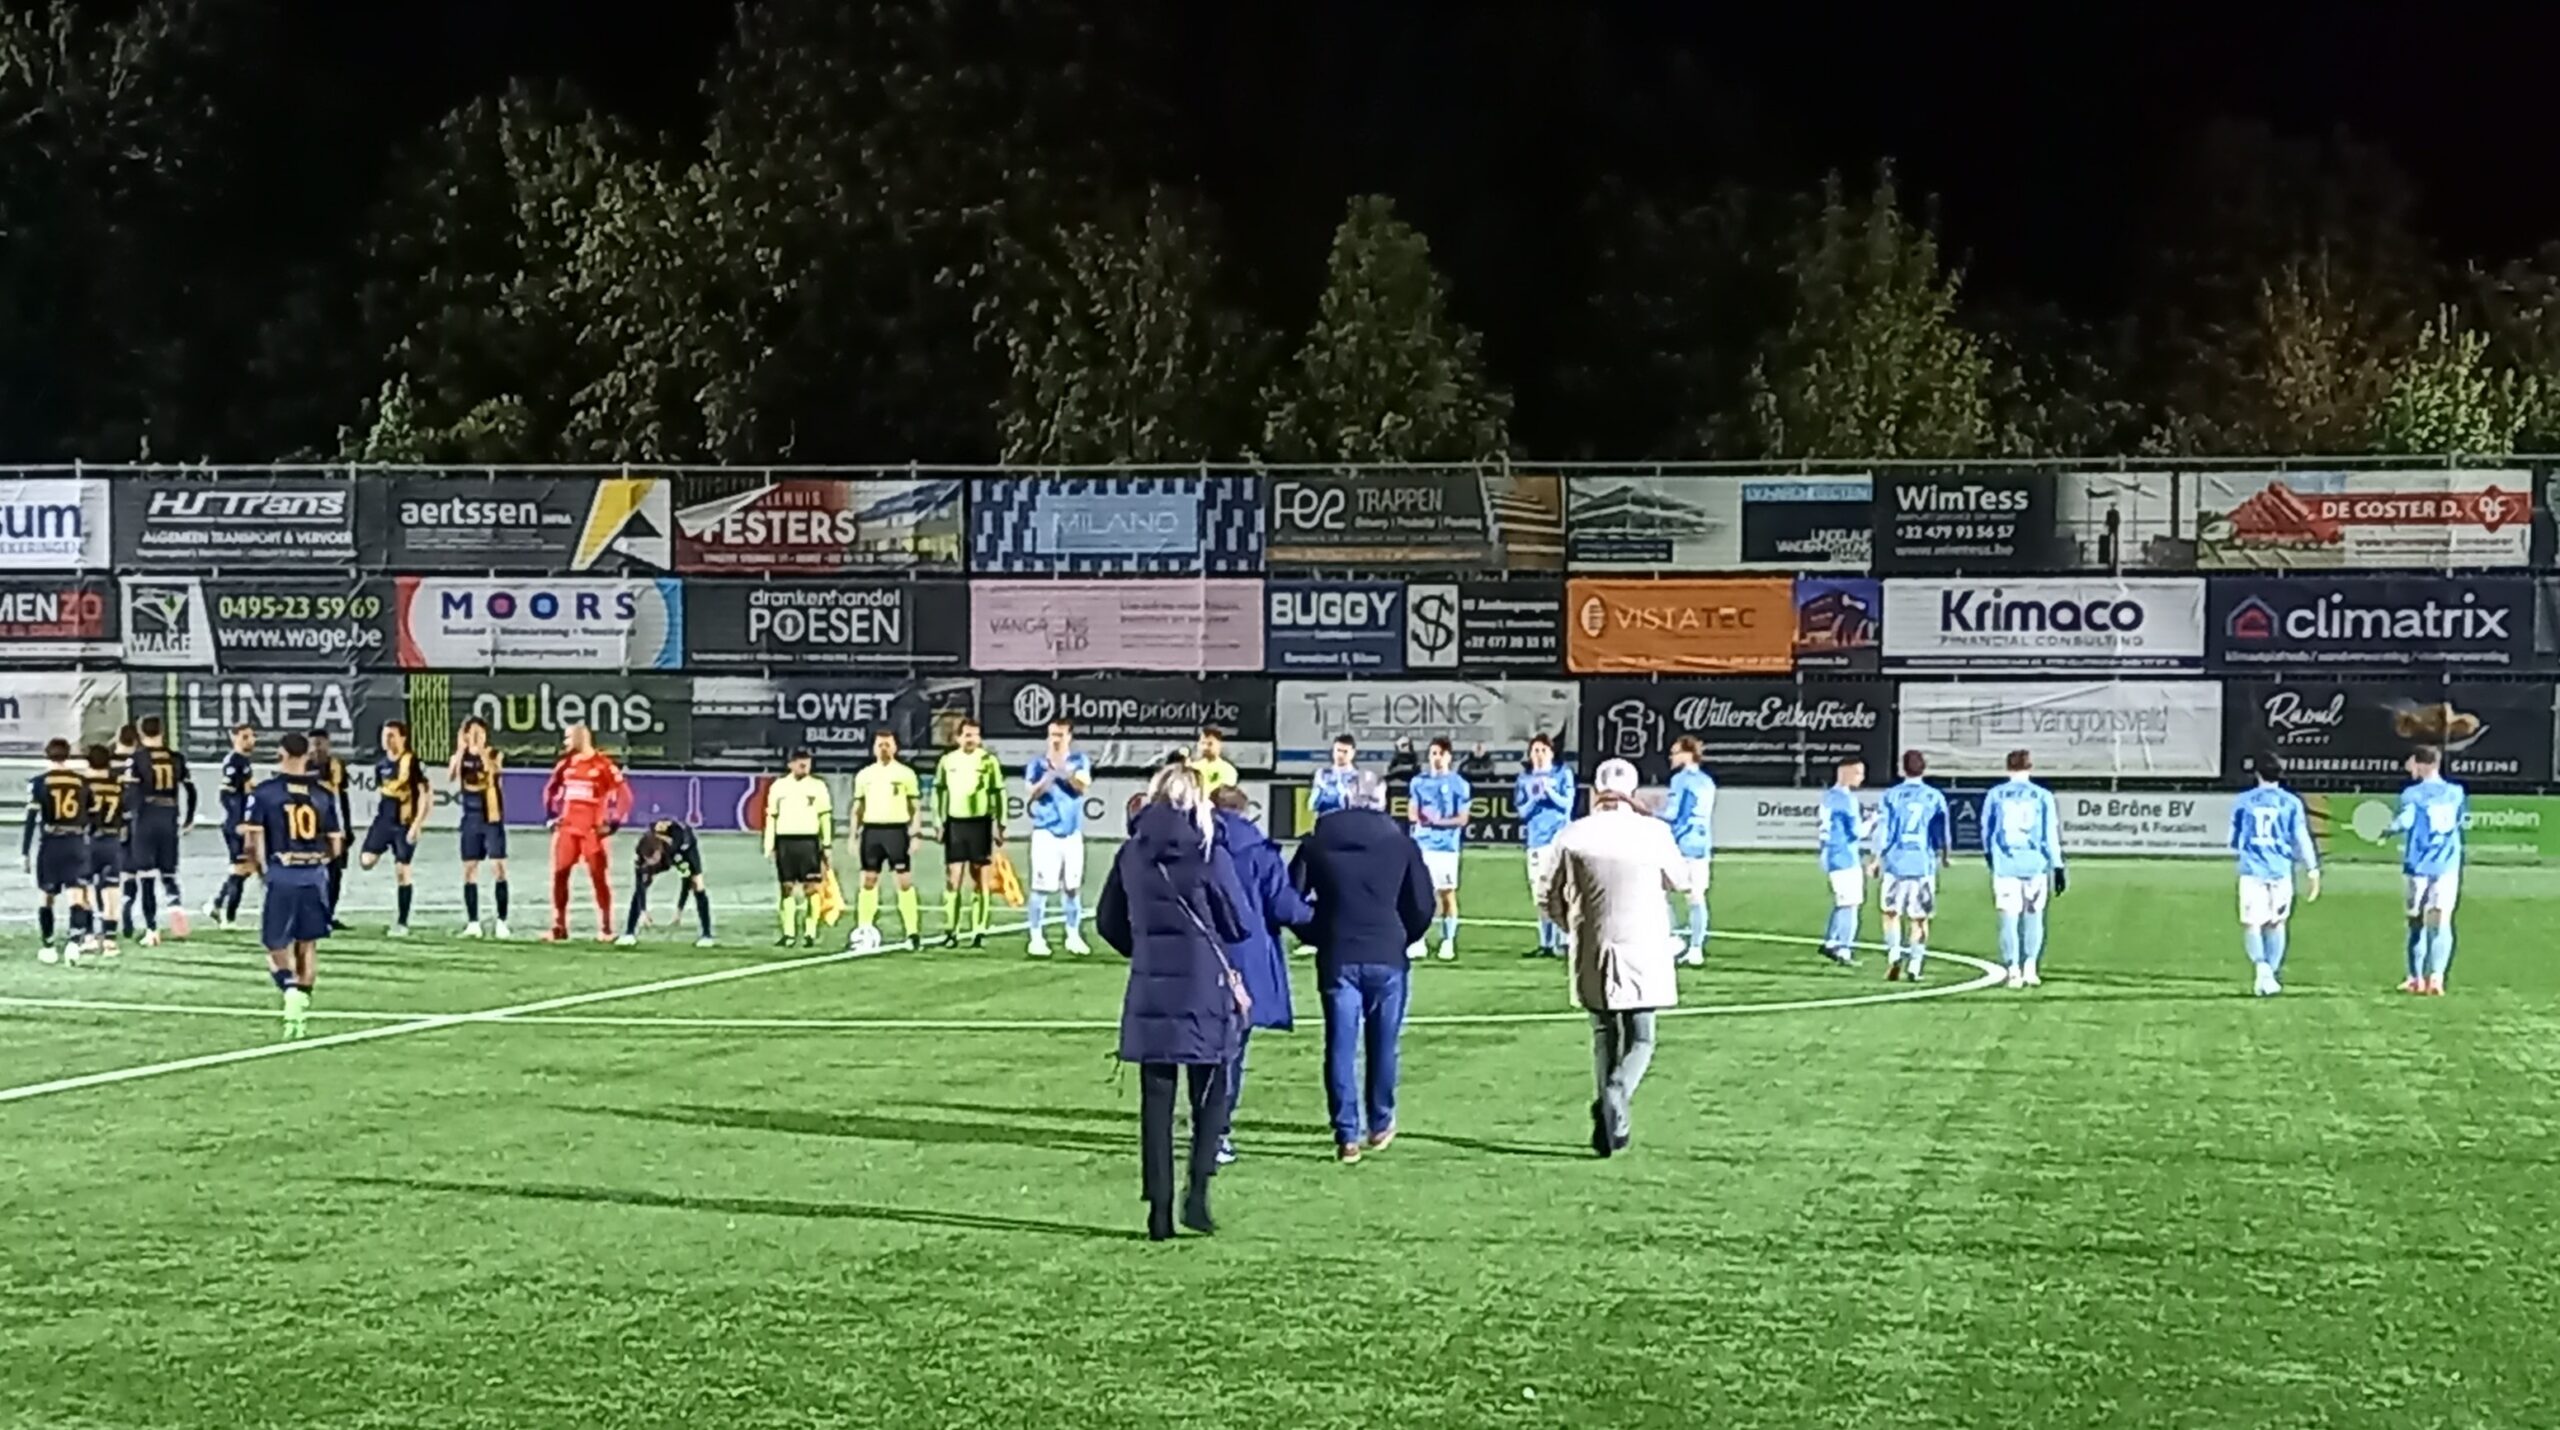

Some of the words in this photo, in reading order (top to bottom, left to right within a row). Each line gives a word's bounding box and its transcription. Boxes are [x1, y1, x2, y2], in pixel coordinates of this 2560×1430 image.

[1356, 488, 1443, 512] TRAPPEN
[1895, 484, 2029, 511] WimTess
[2322, 502, 2349, 518] DE
[2354, 501, 2436, 518] COSTER
[401, 498, 538, 525] aertssen
[1054, 512, 1179, 534] MILANO
[219, 596, 309, 620] 0495-23
[315, 597, 343, 619] 59
[352, 597, 380, 619] 69
[441, 591, 637, 620] MOORS
[750, 589, 900, 607] drankenhandel
[1271, 592, 1398, 626] BUGGY
[1940, 588, 2144, 632] Krimaco
[750, 608, 900, 643] POESEN
[1614, 607, 1757, 630] VISTATEC
[2286, 593, 2510, 638] climatrix
[219, 628, 382, 655] www.wage.be
[188, 683, 352, 728] LINEA
[473, 682, 664, 732] nulens.
[777, 693, 895, 720] LOWET
[2265, 692, 2345, 728] Raoul
[806, 727, 866, 742] BILZEN
[152, 764, 174, 790] 11
[50, 788, 79, 820] 16
[2078, 800, 2102, 816] De
[2168, 800, 2195, 817] BV
[284, 804, 317, 840] 10
